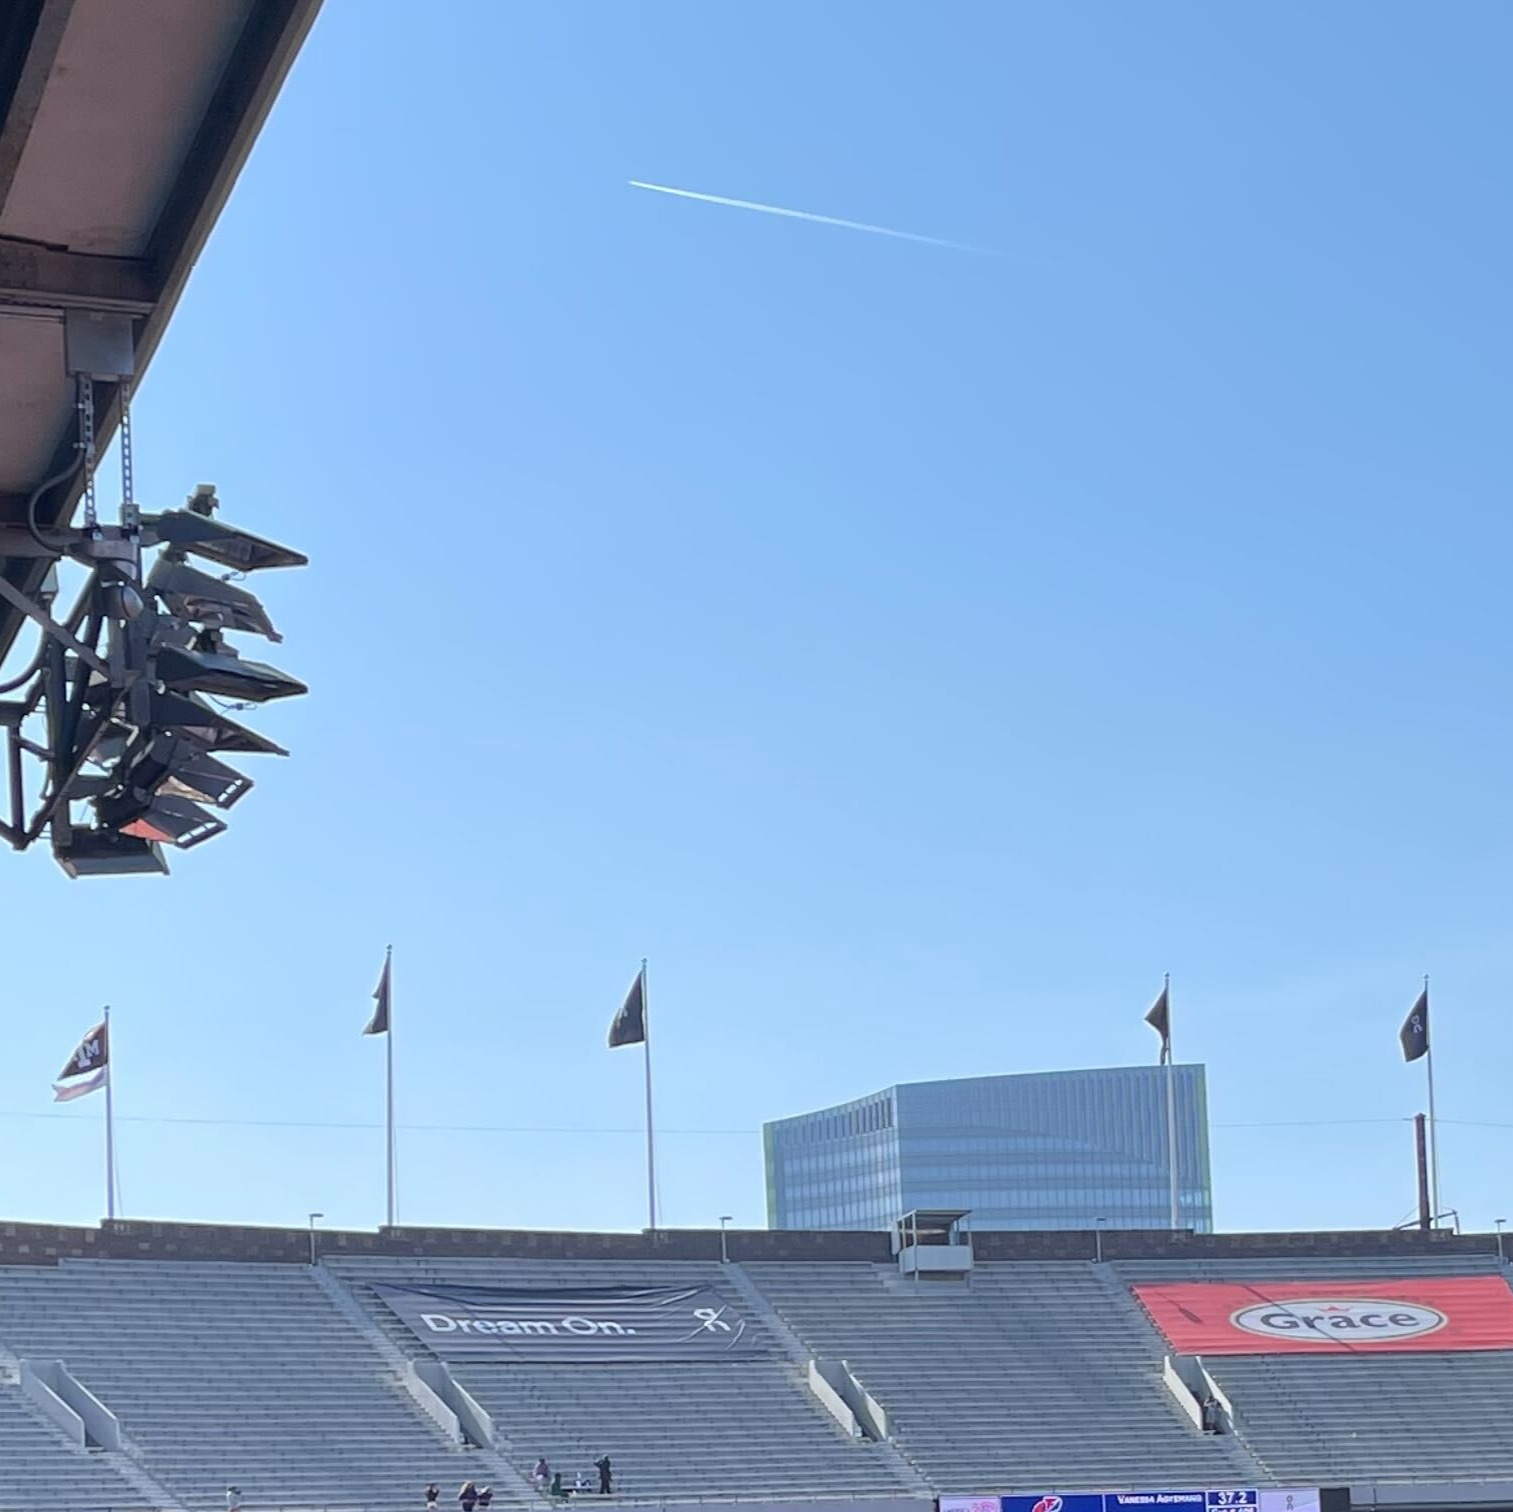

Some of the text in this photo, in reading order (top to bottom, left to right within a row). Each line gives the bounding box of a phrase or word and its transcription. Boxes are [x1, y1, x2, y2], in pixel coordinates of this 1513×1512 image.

[420, 1314, 636, 1335] Dream On.
[1259, 1311, 1421, 1332] Grace
[1218, 1492, 1247, 1504] 37.2
